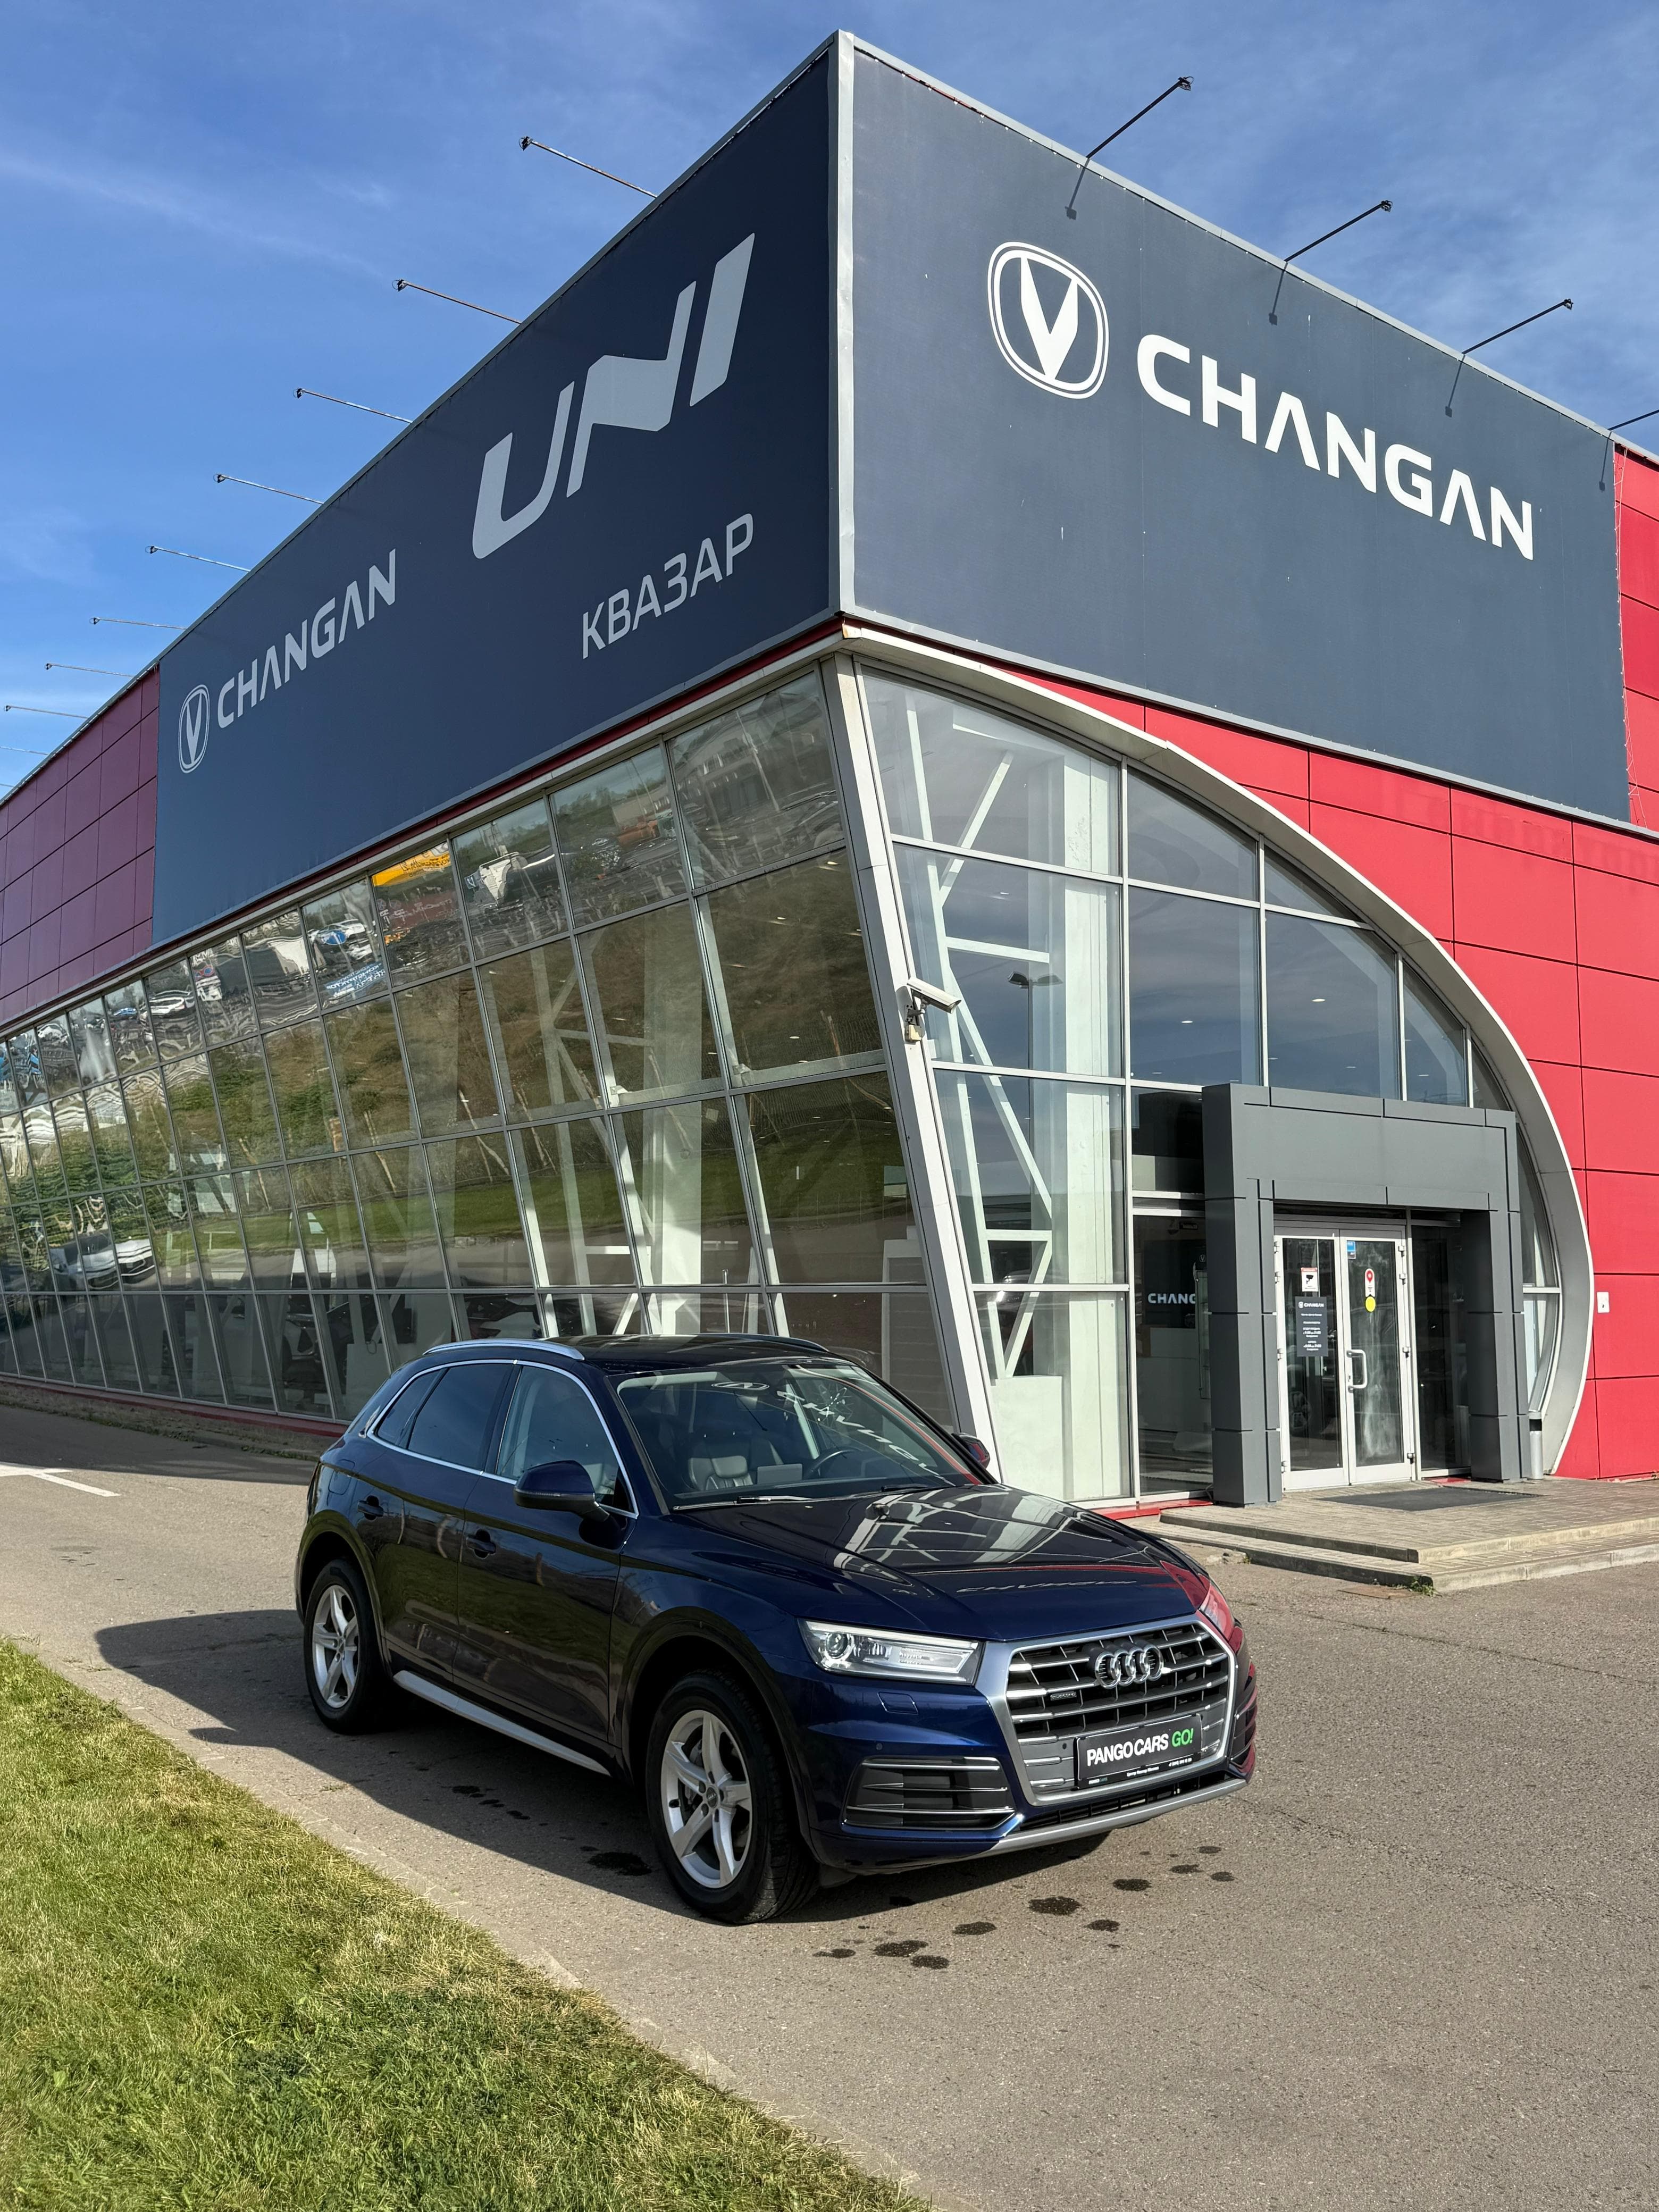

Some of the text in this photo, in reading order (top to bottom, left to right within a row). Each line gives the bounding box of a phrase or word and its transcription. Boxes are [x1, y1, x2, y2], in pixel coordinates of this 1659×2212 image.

[1137, 334, 1534, 560] CHANGAN
[217, 548, 396, 728] CHANGAN
[583, 513, 754, 659] КВАЗАР
[1171, 1728, 1194, 1747] GO!
